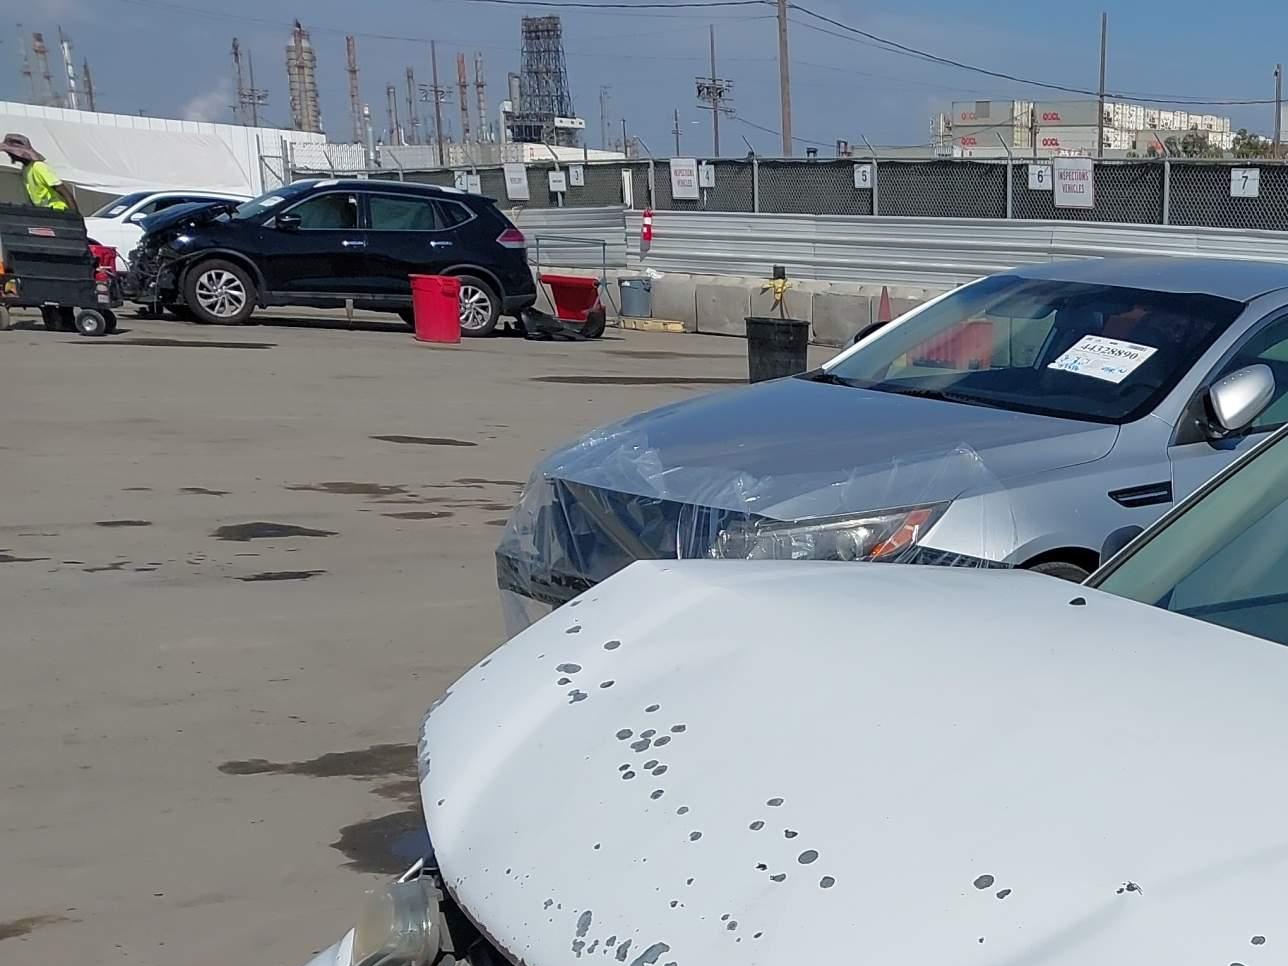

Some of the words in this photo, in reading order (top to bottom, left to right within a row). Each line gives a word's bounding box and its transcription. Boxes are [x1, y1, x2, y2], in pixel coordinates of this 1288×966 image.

[704, 170, 710, 182] 4
[861, 170, 867, 182] 5
[1037, 170, 1043, 183] 6
[1057, 171, 1089, 182] INSPECTIONS
[1062, 183, 1085, 194] VEHICLES
[1241, 175, 1249, 190] 7
[1080, 343, 1139, 360] 44328890
